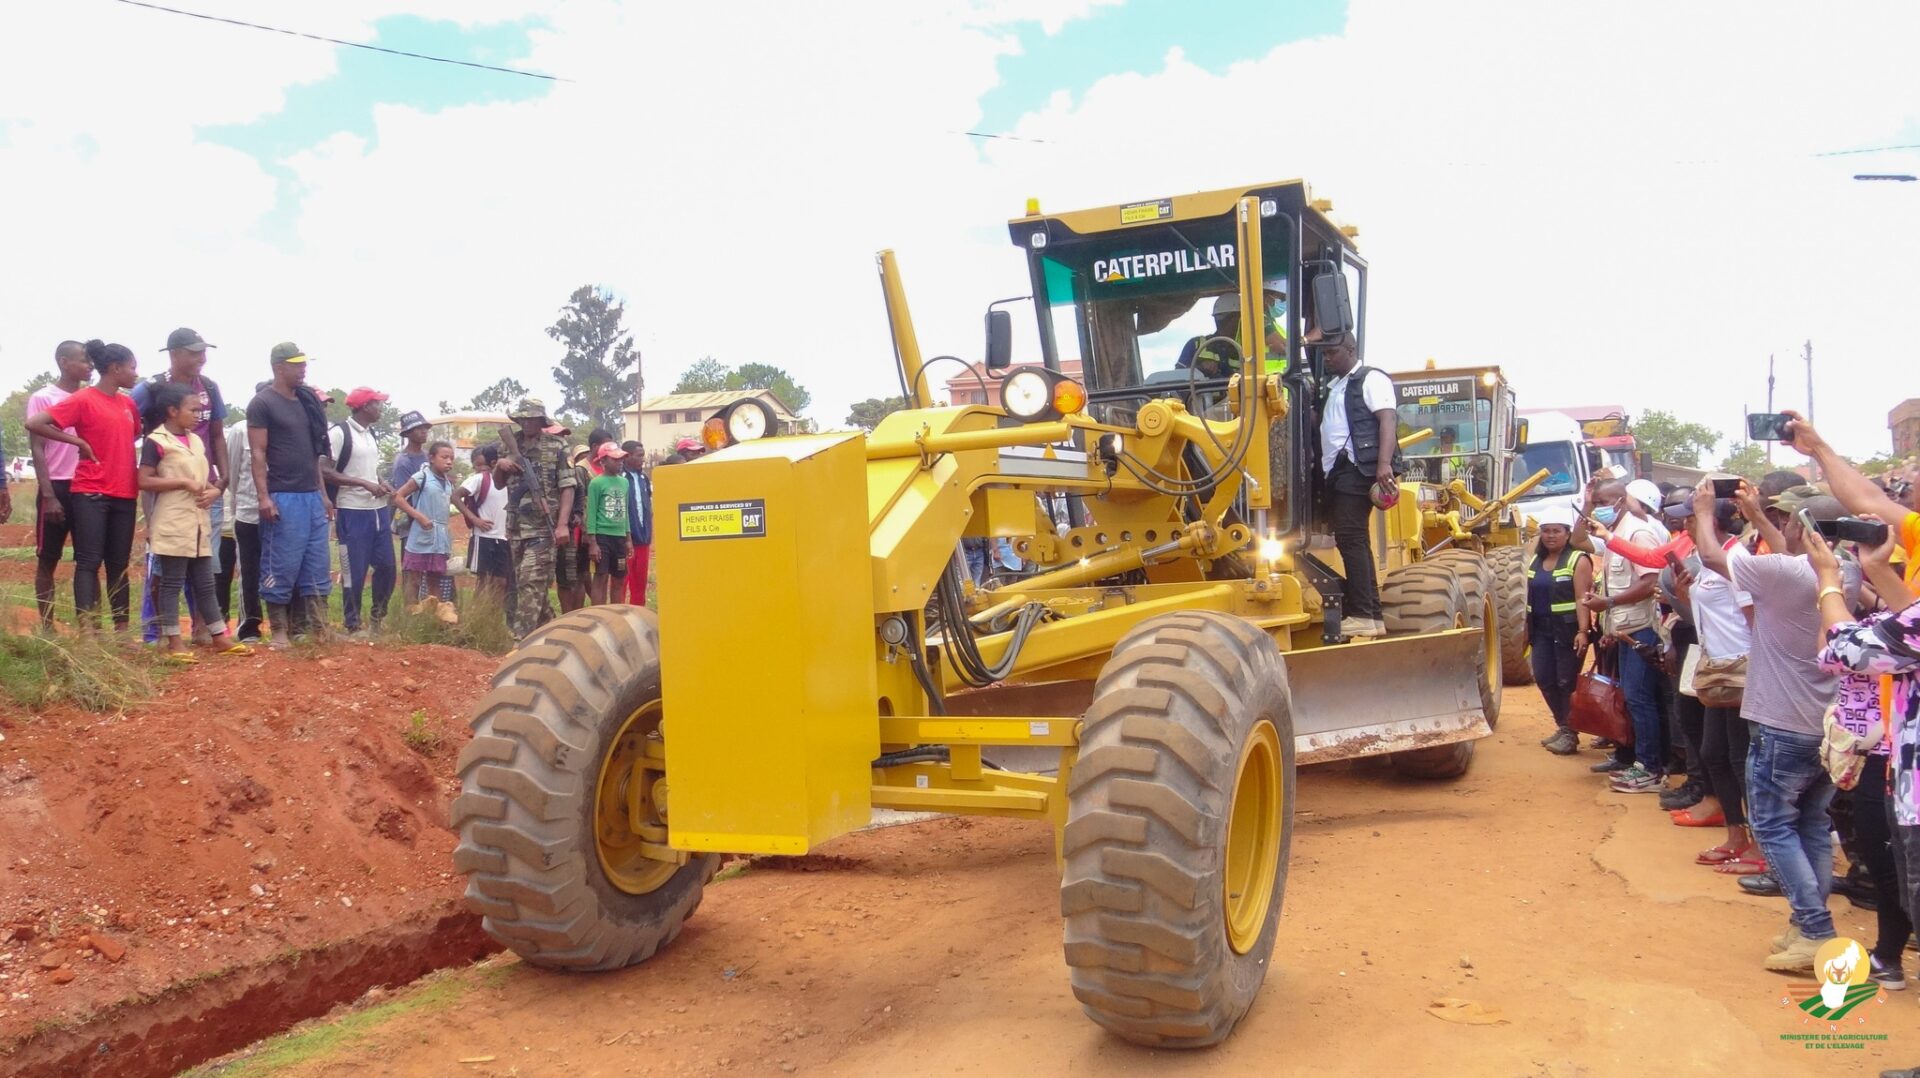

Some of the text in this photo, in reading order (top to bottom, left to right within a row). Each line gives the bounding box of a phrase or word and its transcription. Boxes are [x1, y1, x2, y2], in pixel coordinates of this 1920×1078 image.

[1094, 244, 1235, 282] CATERPILLAR
[1402, 383, 1459, 397] CATERPILLAR
[685, 513, 734, 524] HENRI FRAISE
[743, 514, 760, 528] CAT
[686, 525, 700, 533] FILS
